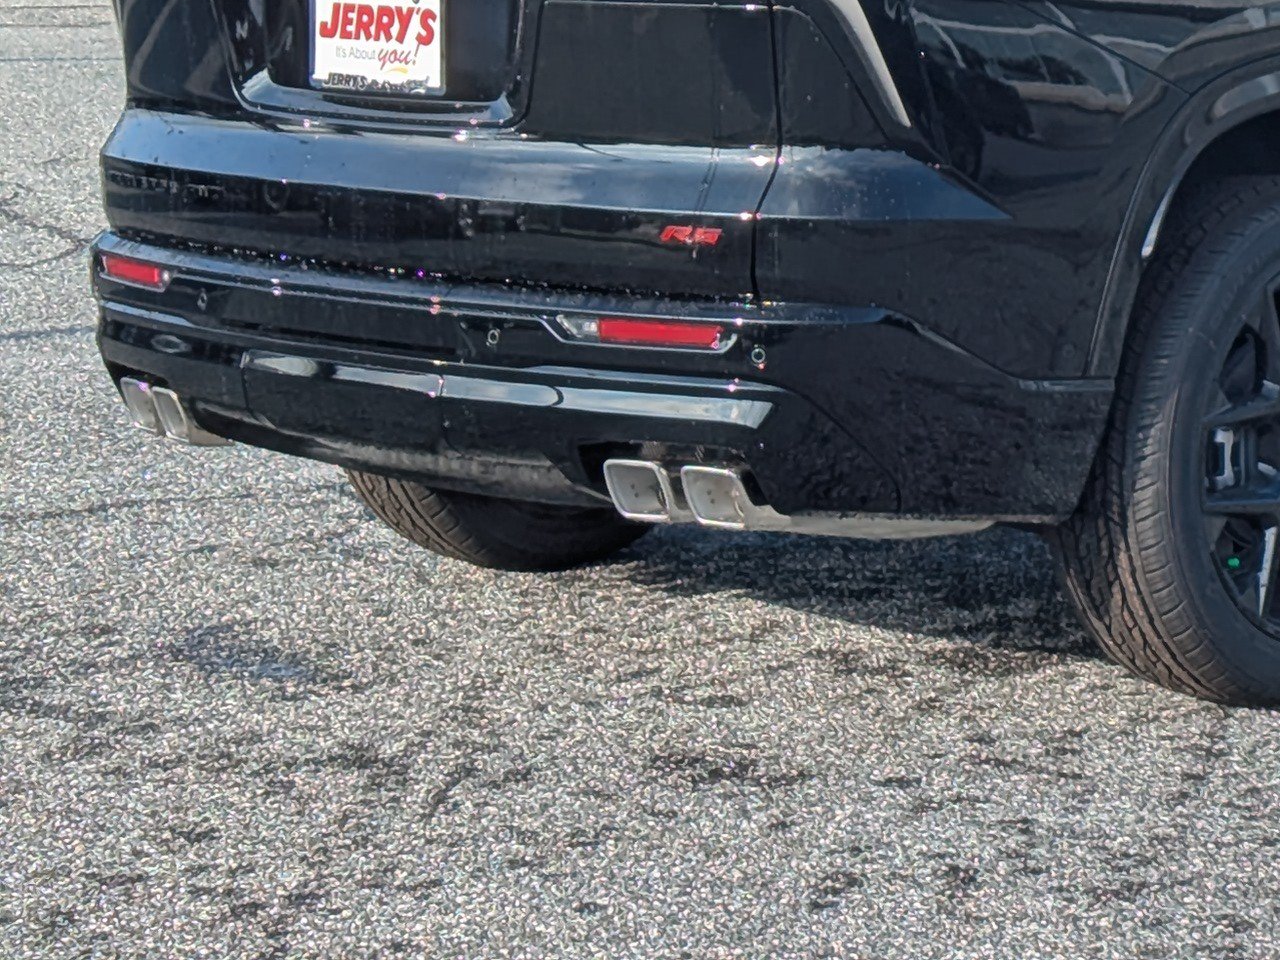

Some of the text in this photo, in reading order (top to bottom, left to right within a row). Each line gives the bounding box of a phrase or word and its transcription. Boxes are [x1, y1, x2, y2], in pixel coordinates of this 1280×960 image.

[320, 2, 437, 46] JERRY'S
[335, 43, 420, 70] It's About you!
